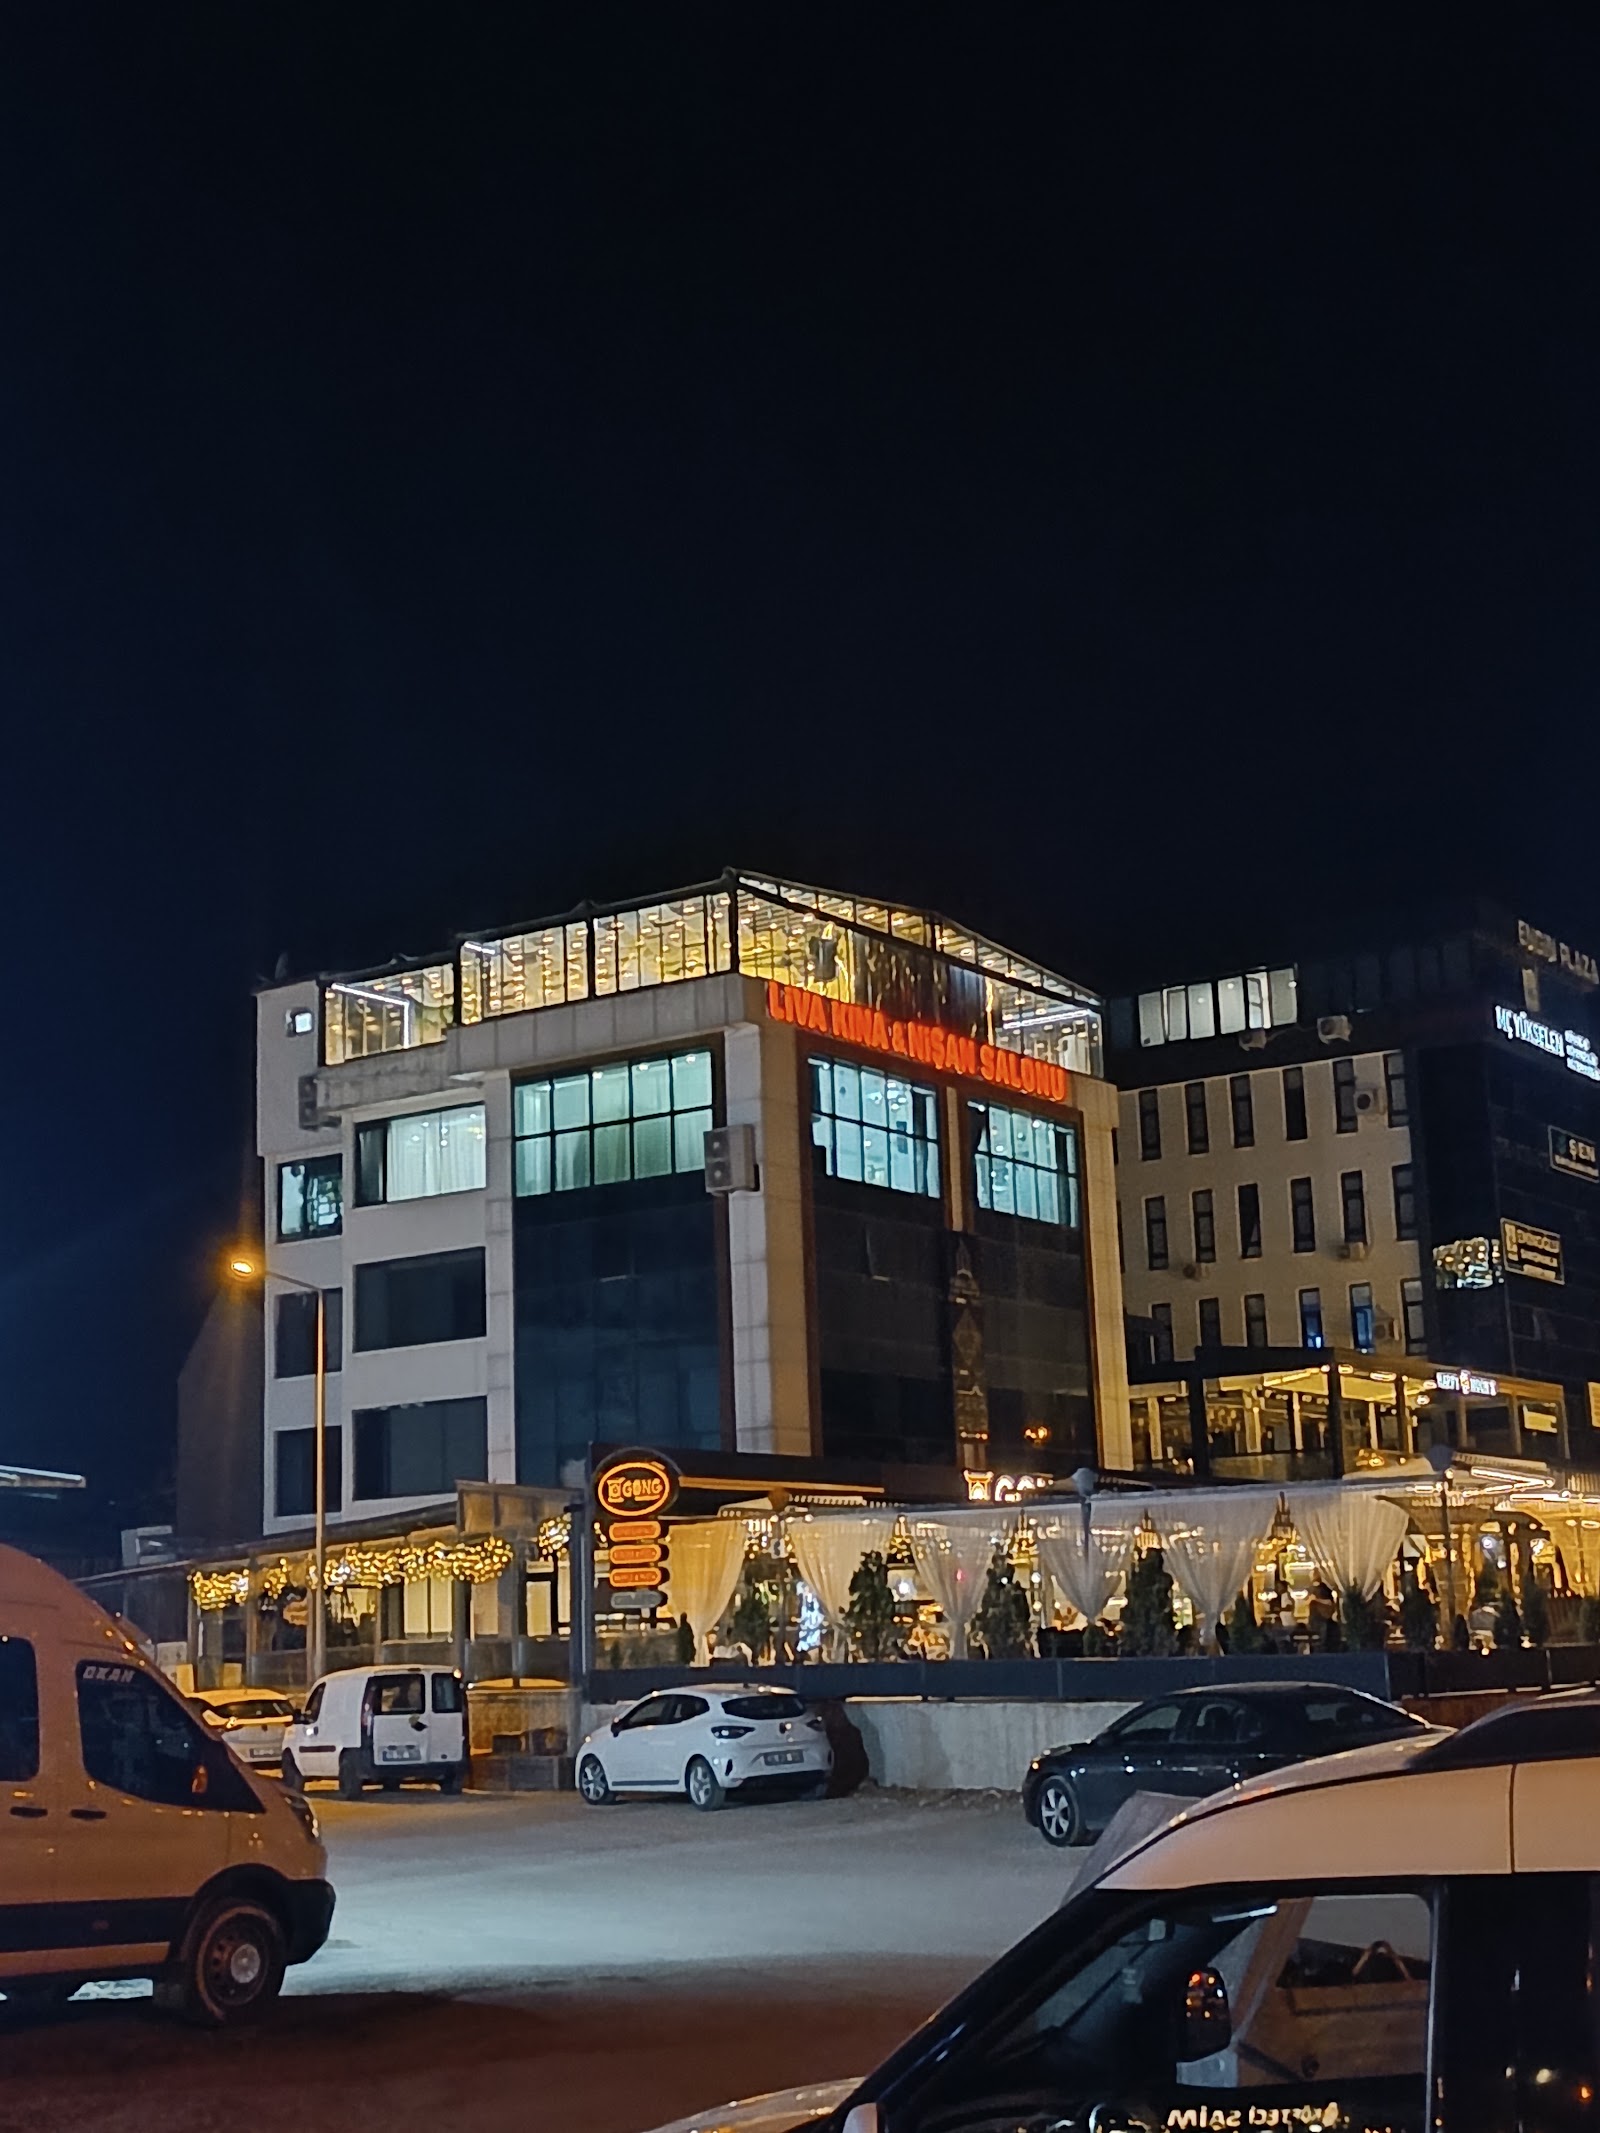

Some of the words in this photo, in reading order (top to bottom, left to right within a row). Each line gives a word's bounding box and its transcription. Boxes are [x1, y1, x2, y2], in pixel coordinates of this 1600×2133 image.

[831, 1000, 889, 1050] KINA
[892, 1021, 906, 1053] &
[980, 1044, 1067, 1101] SALONU
[1513, 1011, 1565, 1057] YÜKSELEN
